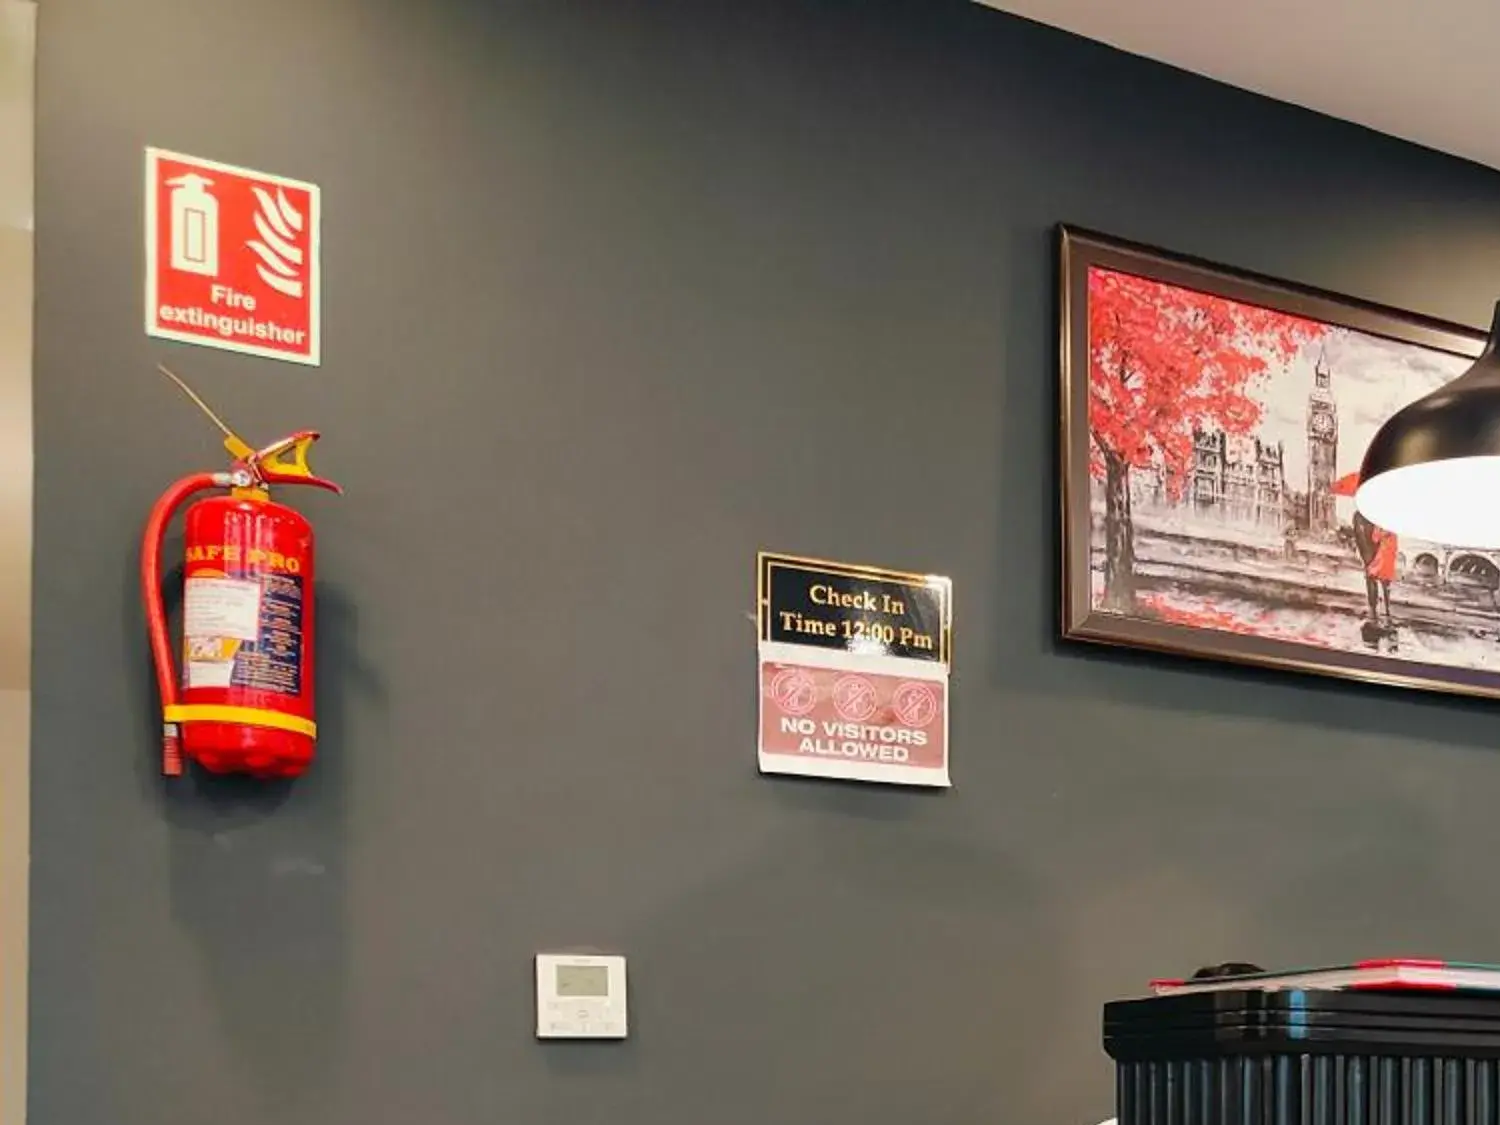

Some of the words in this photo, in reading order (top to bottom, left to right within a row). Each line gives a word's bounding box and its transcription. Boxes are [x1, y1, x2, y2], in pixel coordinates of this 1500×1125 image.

[210, 284, 256, 311] Fire
[159, 304, 305, 345] extinguisher
[809, 584, 877, 611] Check
[883, 594, 905, 615] In
[779, 611, 837, 637] Time
[841, 619, 894, 643] 12:00
[900, 627, 933, 650] Pm
[780, 717, 816, 734] NO
[822, 720, 928, 746] VISITORS
[799, 737, 909, 763] ALLOWED
